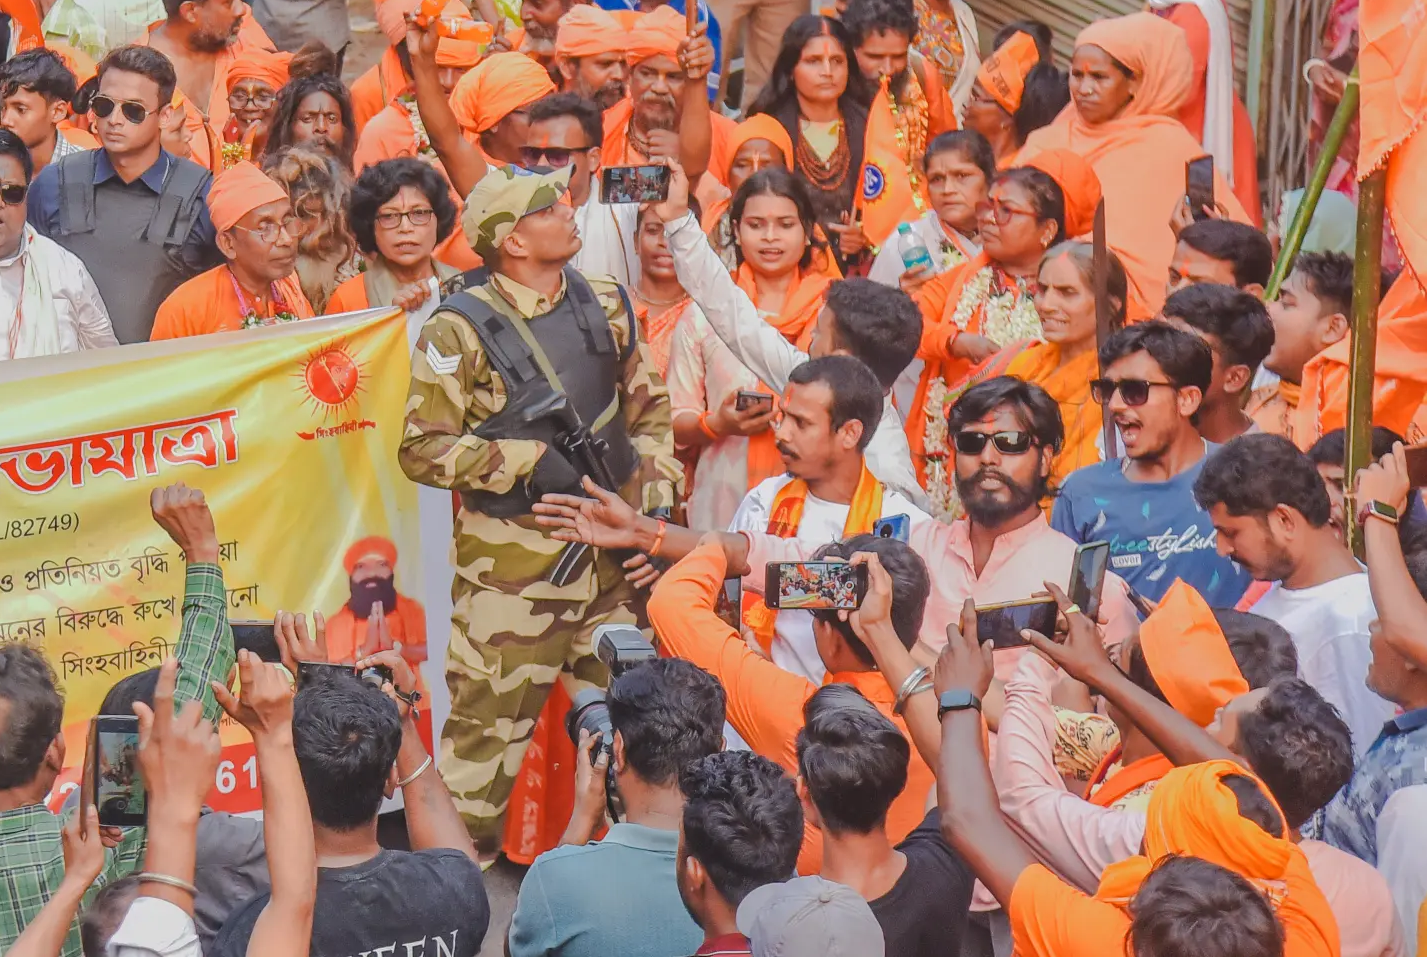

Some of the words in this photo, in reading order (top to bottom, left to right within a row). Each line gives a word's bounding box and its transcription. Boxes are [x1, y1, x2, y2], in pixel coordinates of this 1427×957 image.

[25, 556, 121, 591] প্রতিনিয়ত
[56, 606, 125, 635] বিরুদ্ধে
[133, 594, 177, 621] রুখে
